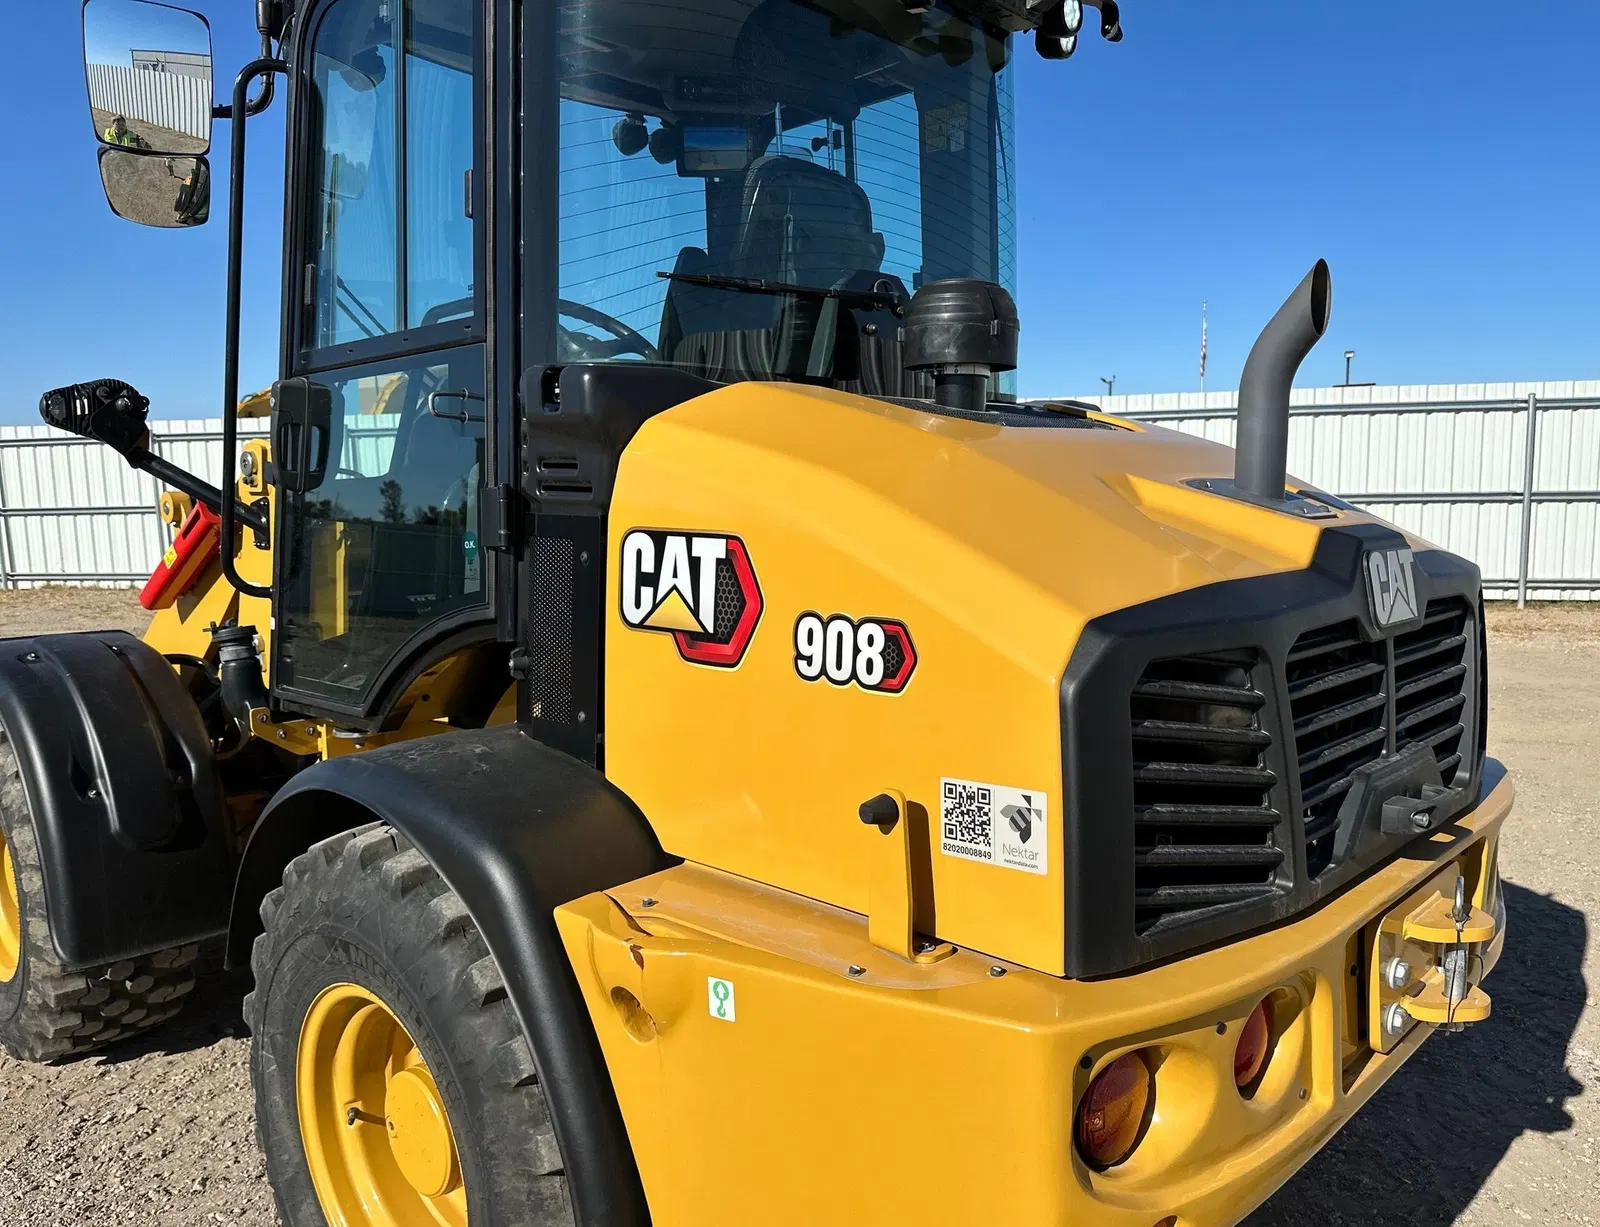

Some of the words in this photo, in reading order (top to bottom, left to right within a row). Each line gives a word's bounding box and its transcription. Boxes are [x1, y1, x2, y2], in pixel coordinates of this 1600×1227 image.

[622, 531, 727, 634] CAT
[1369, 548, 1418, 625] CAT
[797, 615, 885, 686] 908
[942, 842, 992, 860] 82020008849
[1002, 842, 1040, 861] Nektar
[1003, 858, 1039, 870] nektardata.com
